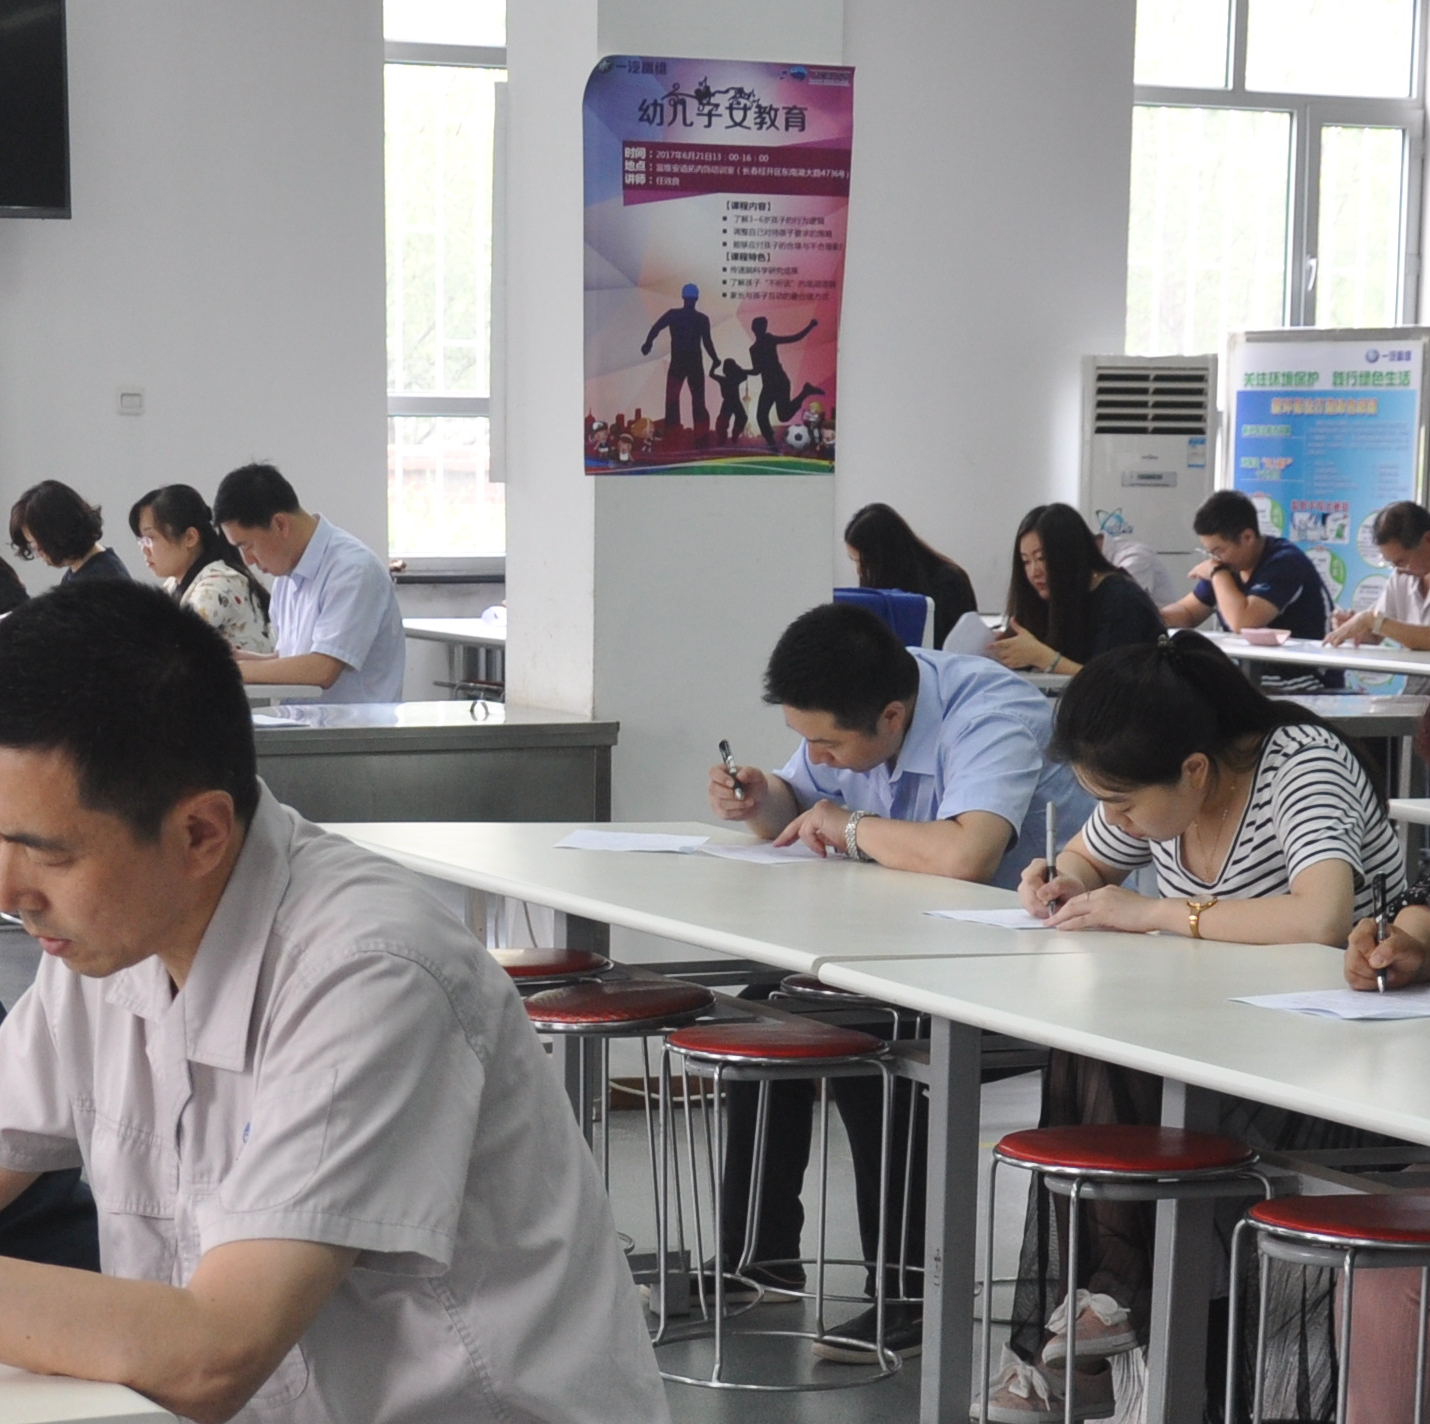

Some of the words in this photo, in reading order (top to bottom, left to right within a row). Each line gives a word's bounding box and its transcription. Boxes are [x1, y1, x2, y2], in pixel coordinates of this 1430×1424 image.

[1243, 371, 1320, 387] 关注环境保护
[1332, 370, 1412, 387] 践行绿色生活
